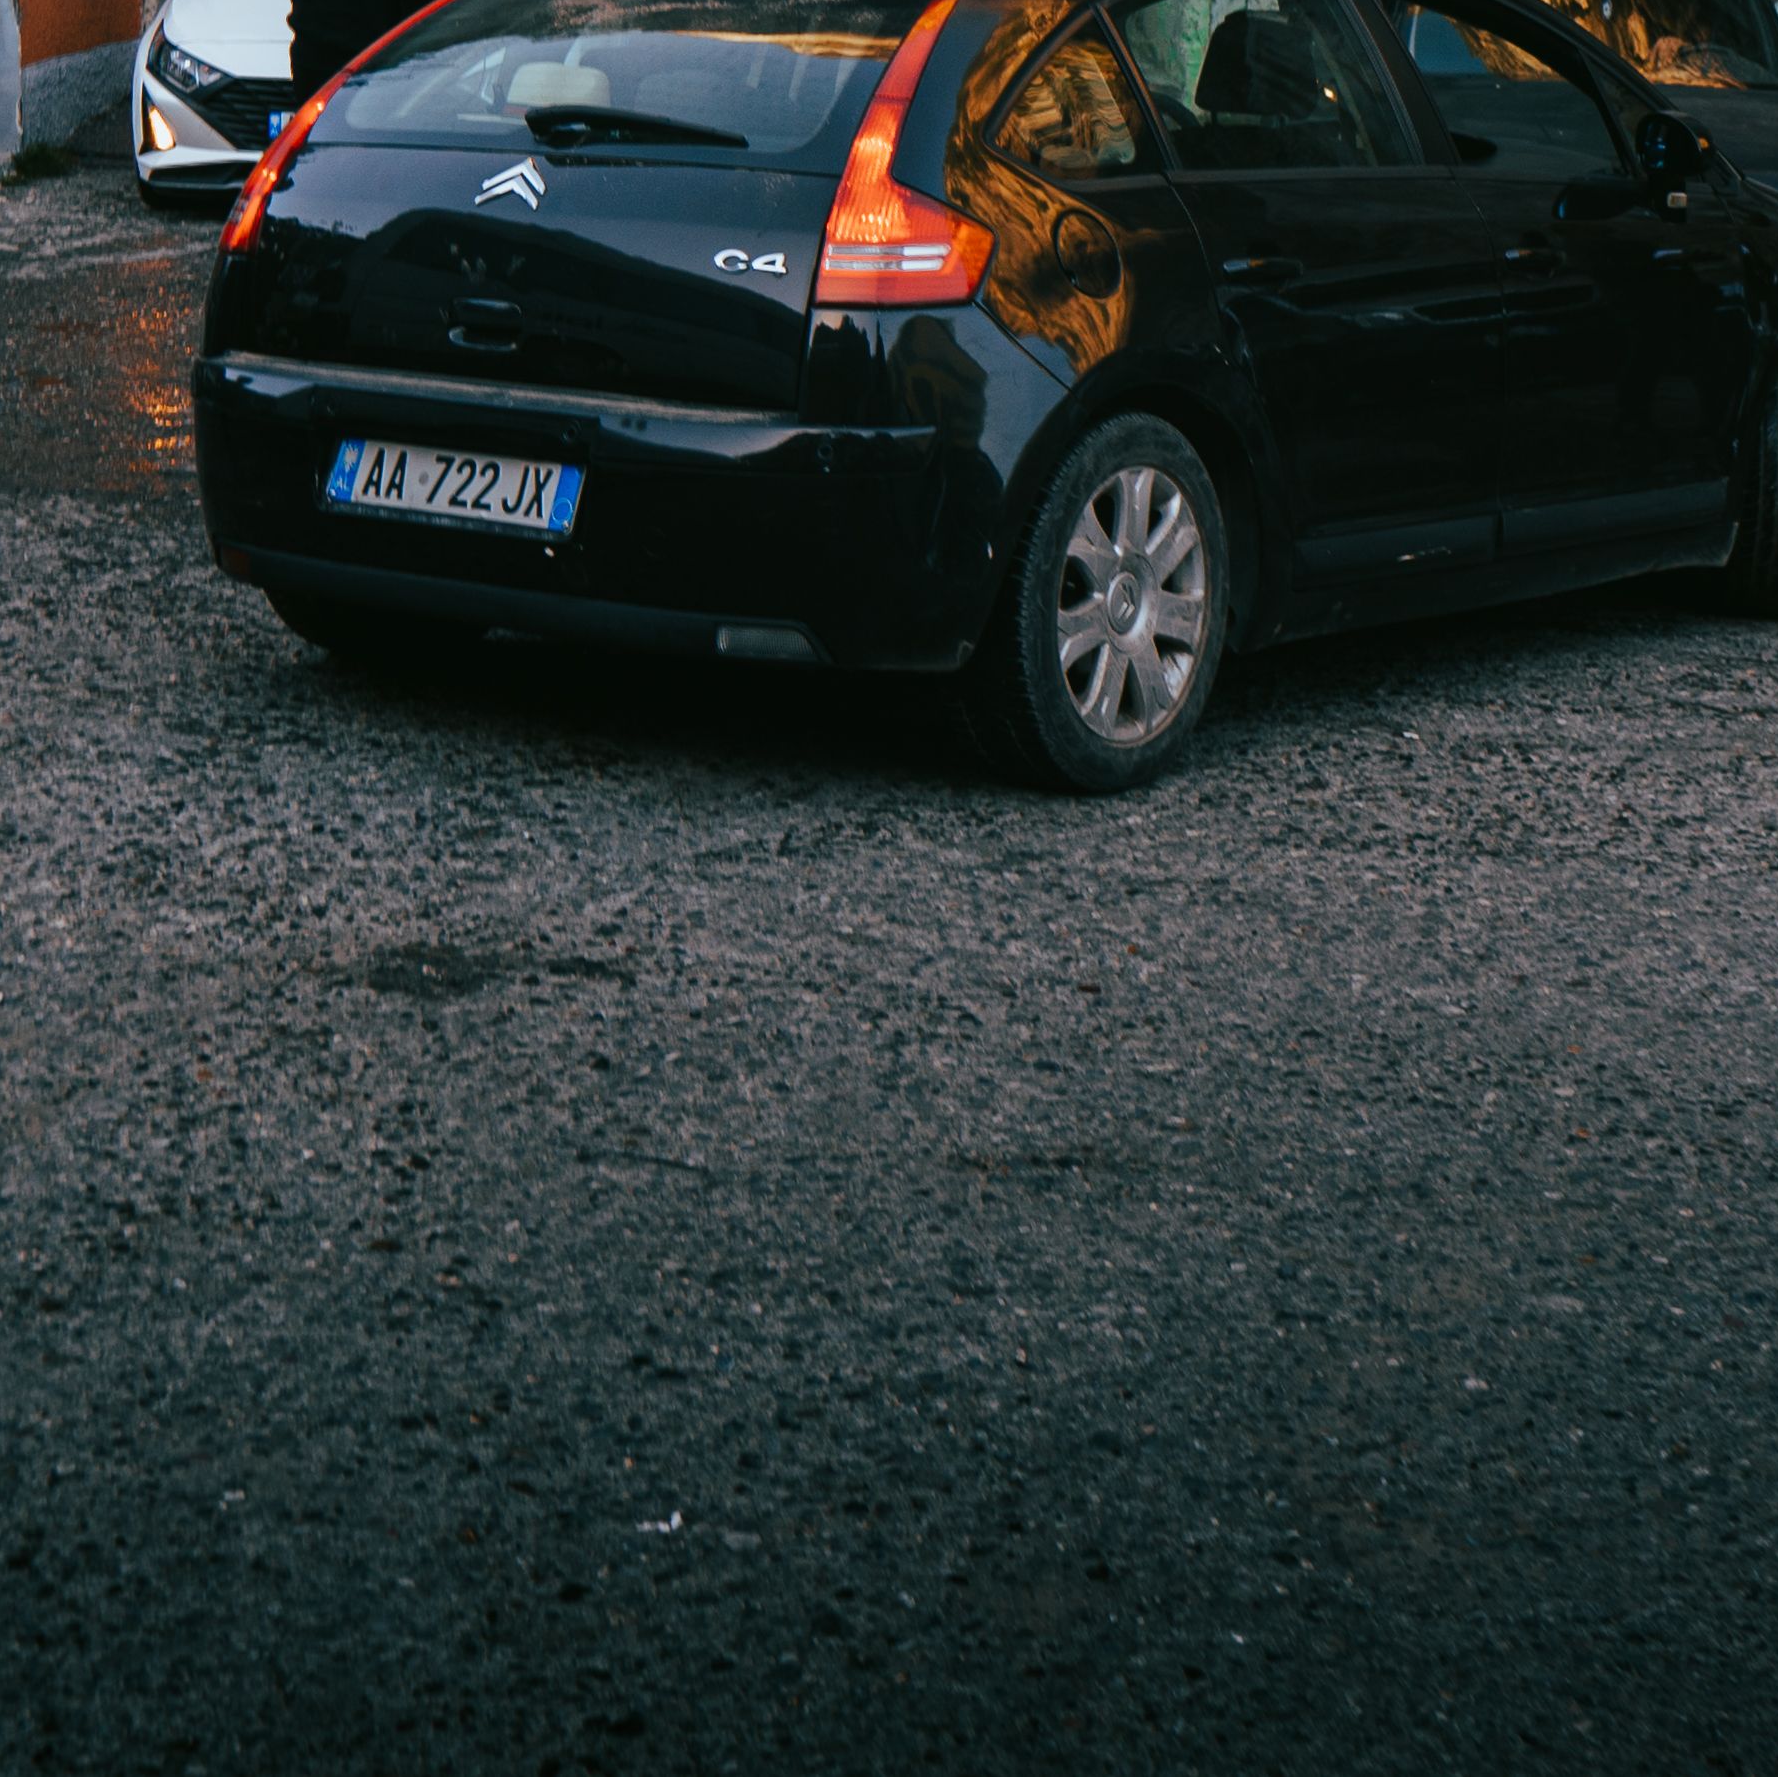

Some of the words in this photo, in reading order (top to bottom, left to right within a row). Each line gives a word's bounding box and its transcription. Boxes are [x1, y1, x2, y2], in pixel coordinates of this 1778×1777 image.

[714, 249, 787, 274] C4
[362, 447, 408, 500] AA
[426, 454, 500, 511] 722
[501, 465, 554, 519] JX
